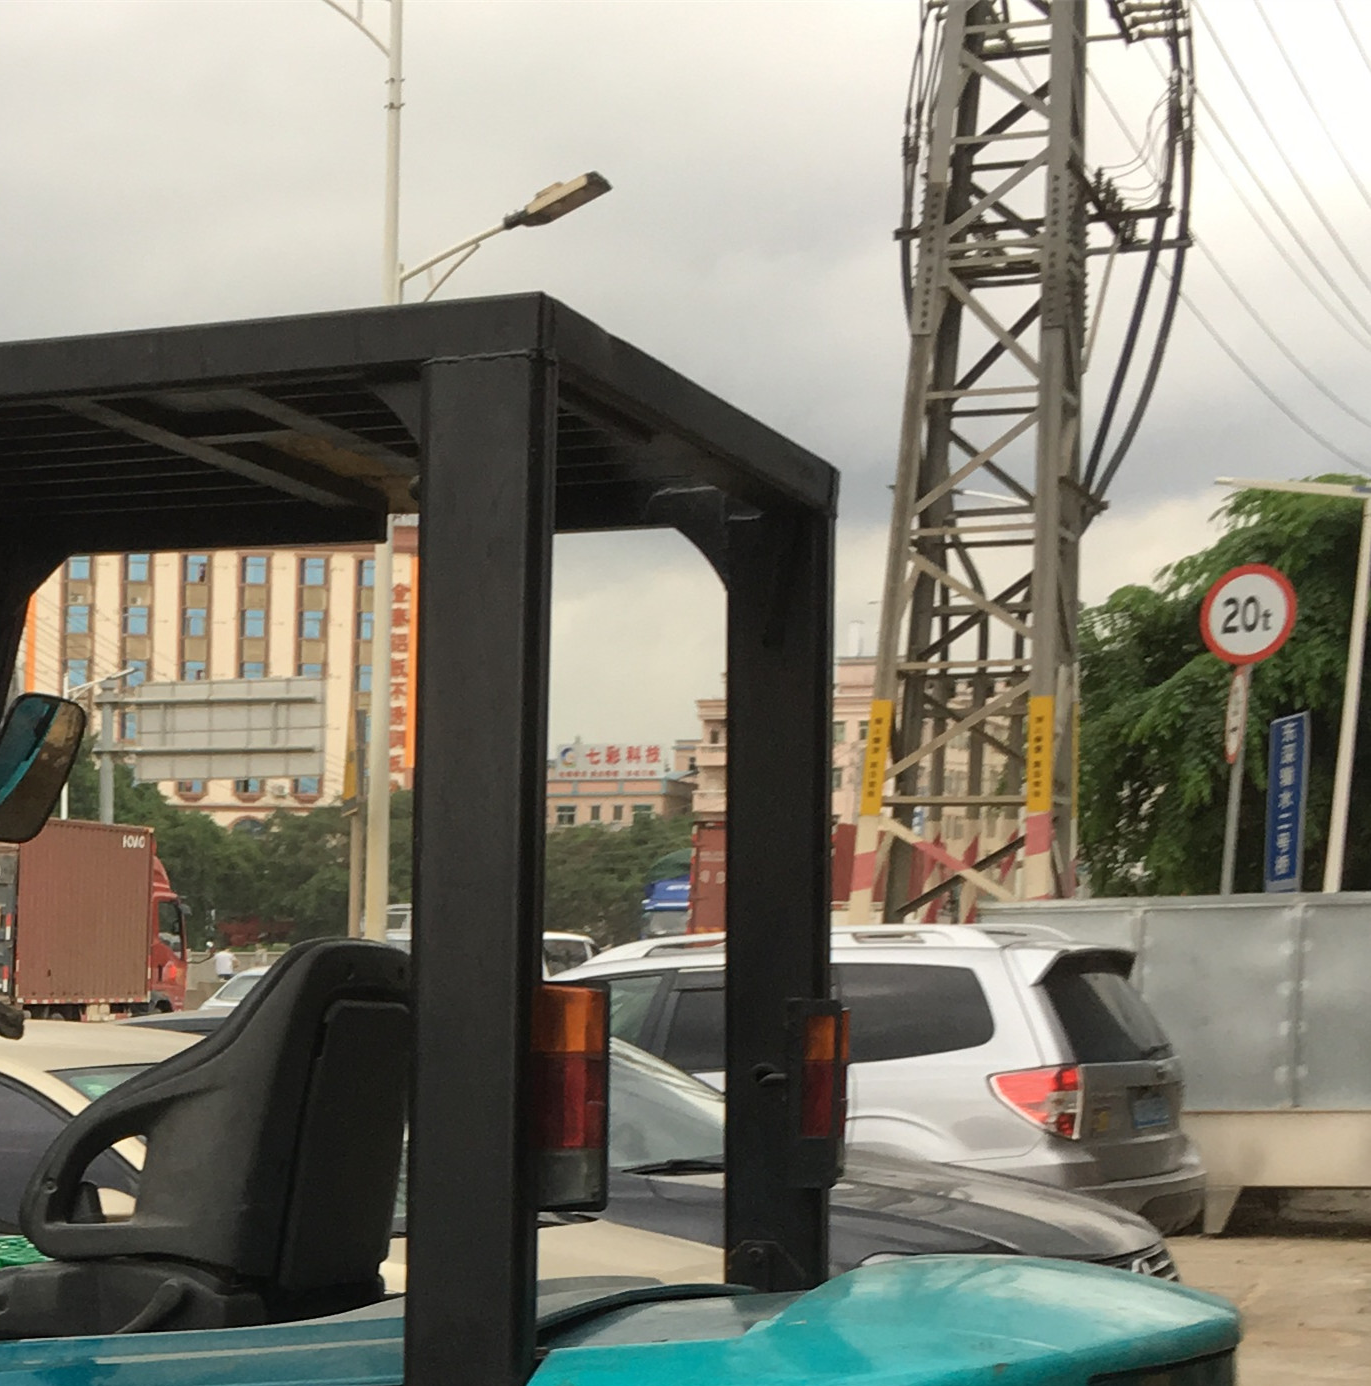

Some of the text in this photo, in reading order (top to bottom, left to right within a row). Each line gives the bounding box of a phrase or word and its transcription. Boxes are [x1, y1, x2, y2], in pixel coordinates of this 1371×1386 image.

[1221, 596, 1272, 633] 20t
[586, 745, 661, 765] 七彩科技
